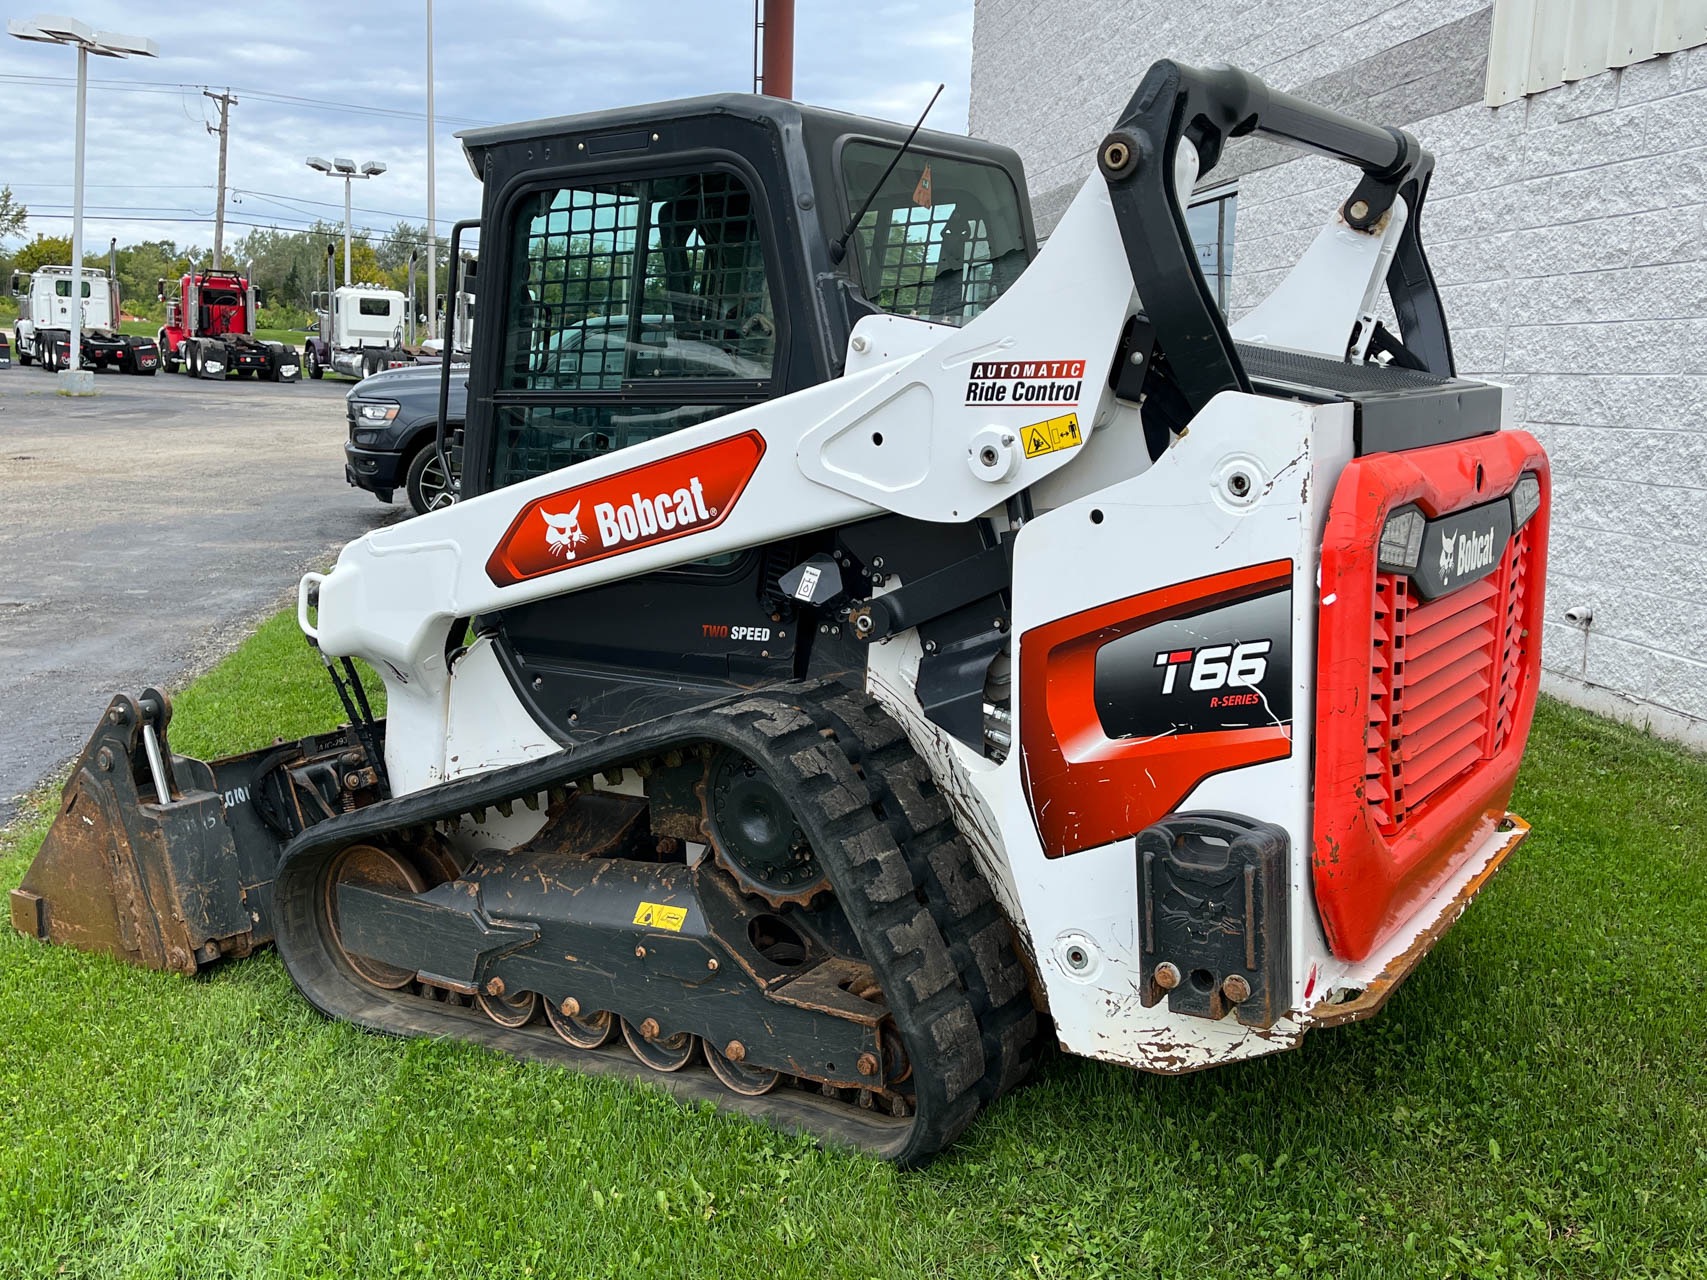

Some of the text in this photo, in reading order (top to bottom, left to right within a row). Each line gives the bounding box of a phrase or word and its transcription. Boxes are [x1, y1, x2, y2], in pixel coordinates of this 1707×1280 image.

[974, 363, 1081, 378] AUTOMATIC
[965, 380, 1082, 402] Ride Control
[593, 476, 710, 548] Bobcat
[1456, 526, 1495, 577] Bobcat
[702, 624, 771, 641] TWO SPEED
[1155, 640, 1271, 695] T66
[1209, 693, 1259, 708] R-SERIES
